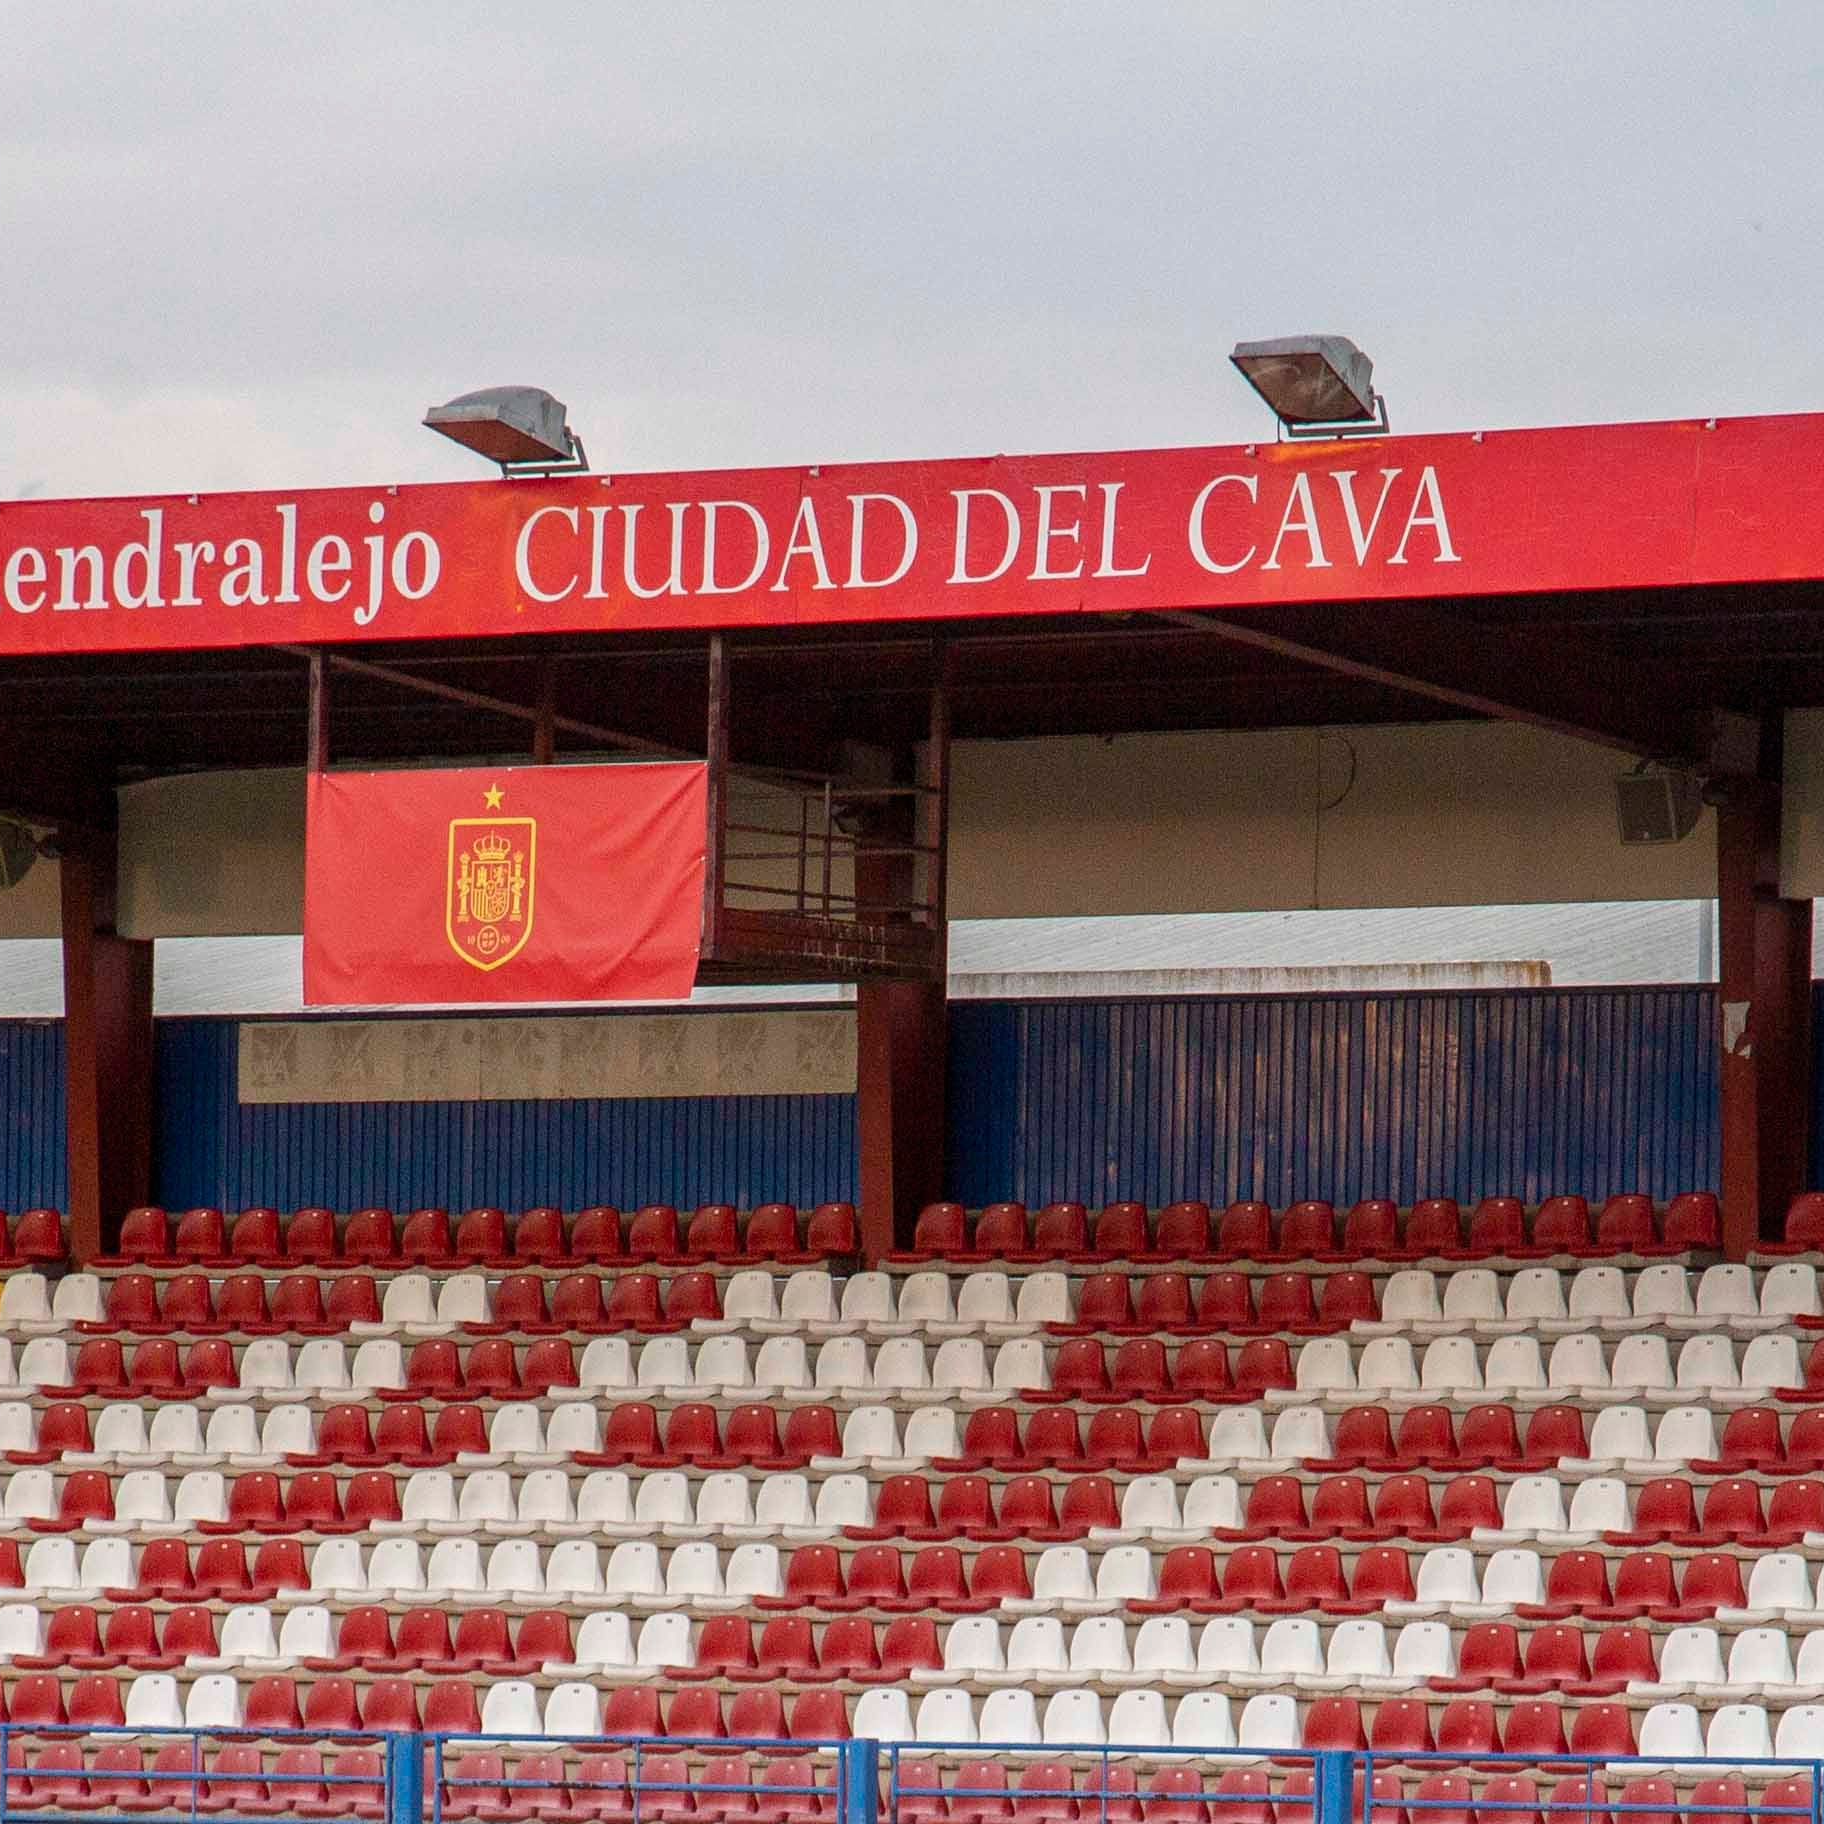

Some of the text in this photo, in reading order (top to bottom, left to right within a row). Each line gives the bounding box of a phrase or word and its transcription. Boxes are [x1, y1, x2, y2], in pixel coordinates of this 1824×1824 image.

[514, 493, 919, 604] CIUDAD
[944, 482, 1153, 585] DEL
[1187, 465, 1463, 575] CAVA
